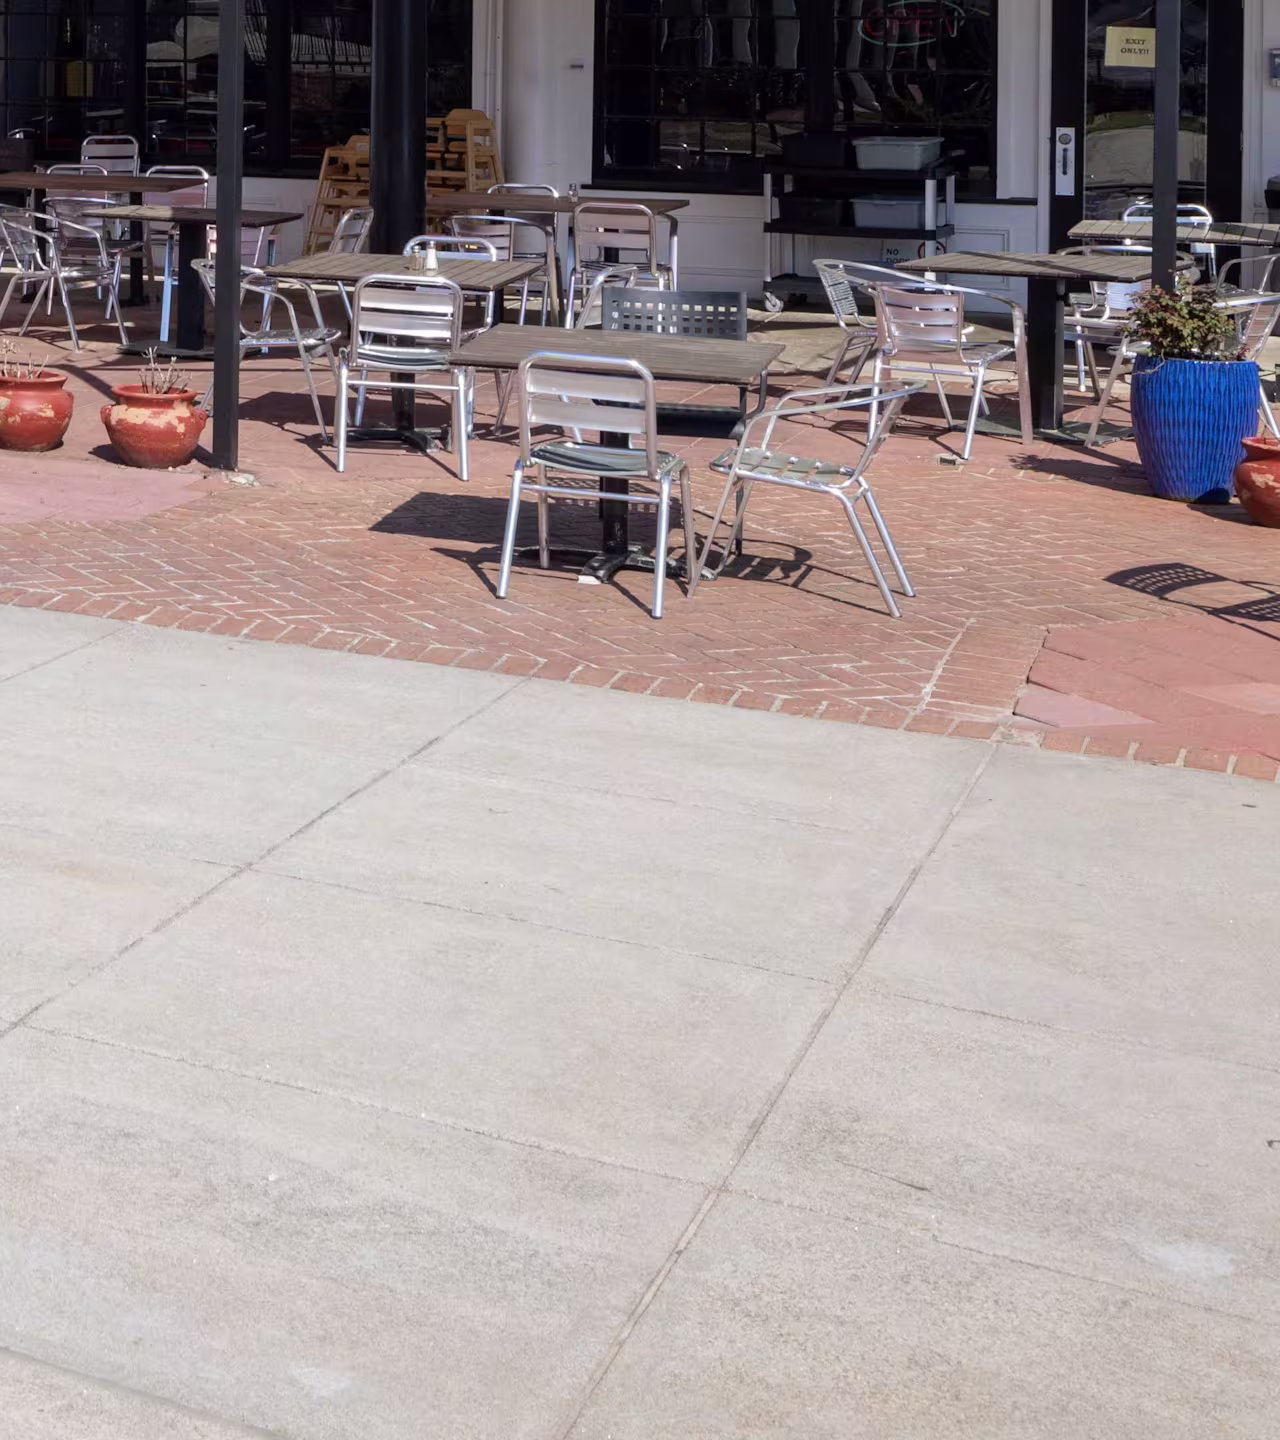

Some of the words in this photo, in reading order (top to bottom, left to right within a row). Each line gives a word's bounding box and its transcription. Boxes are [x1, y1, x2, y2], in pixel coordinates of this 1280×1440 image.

[863, 7, 958, 38] OPEN
[1120, 47, 1149, 55] ONLY!!
[886, 248, 899, 256] NO
